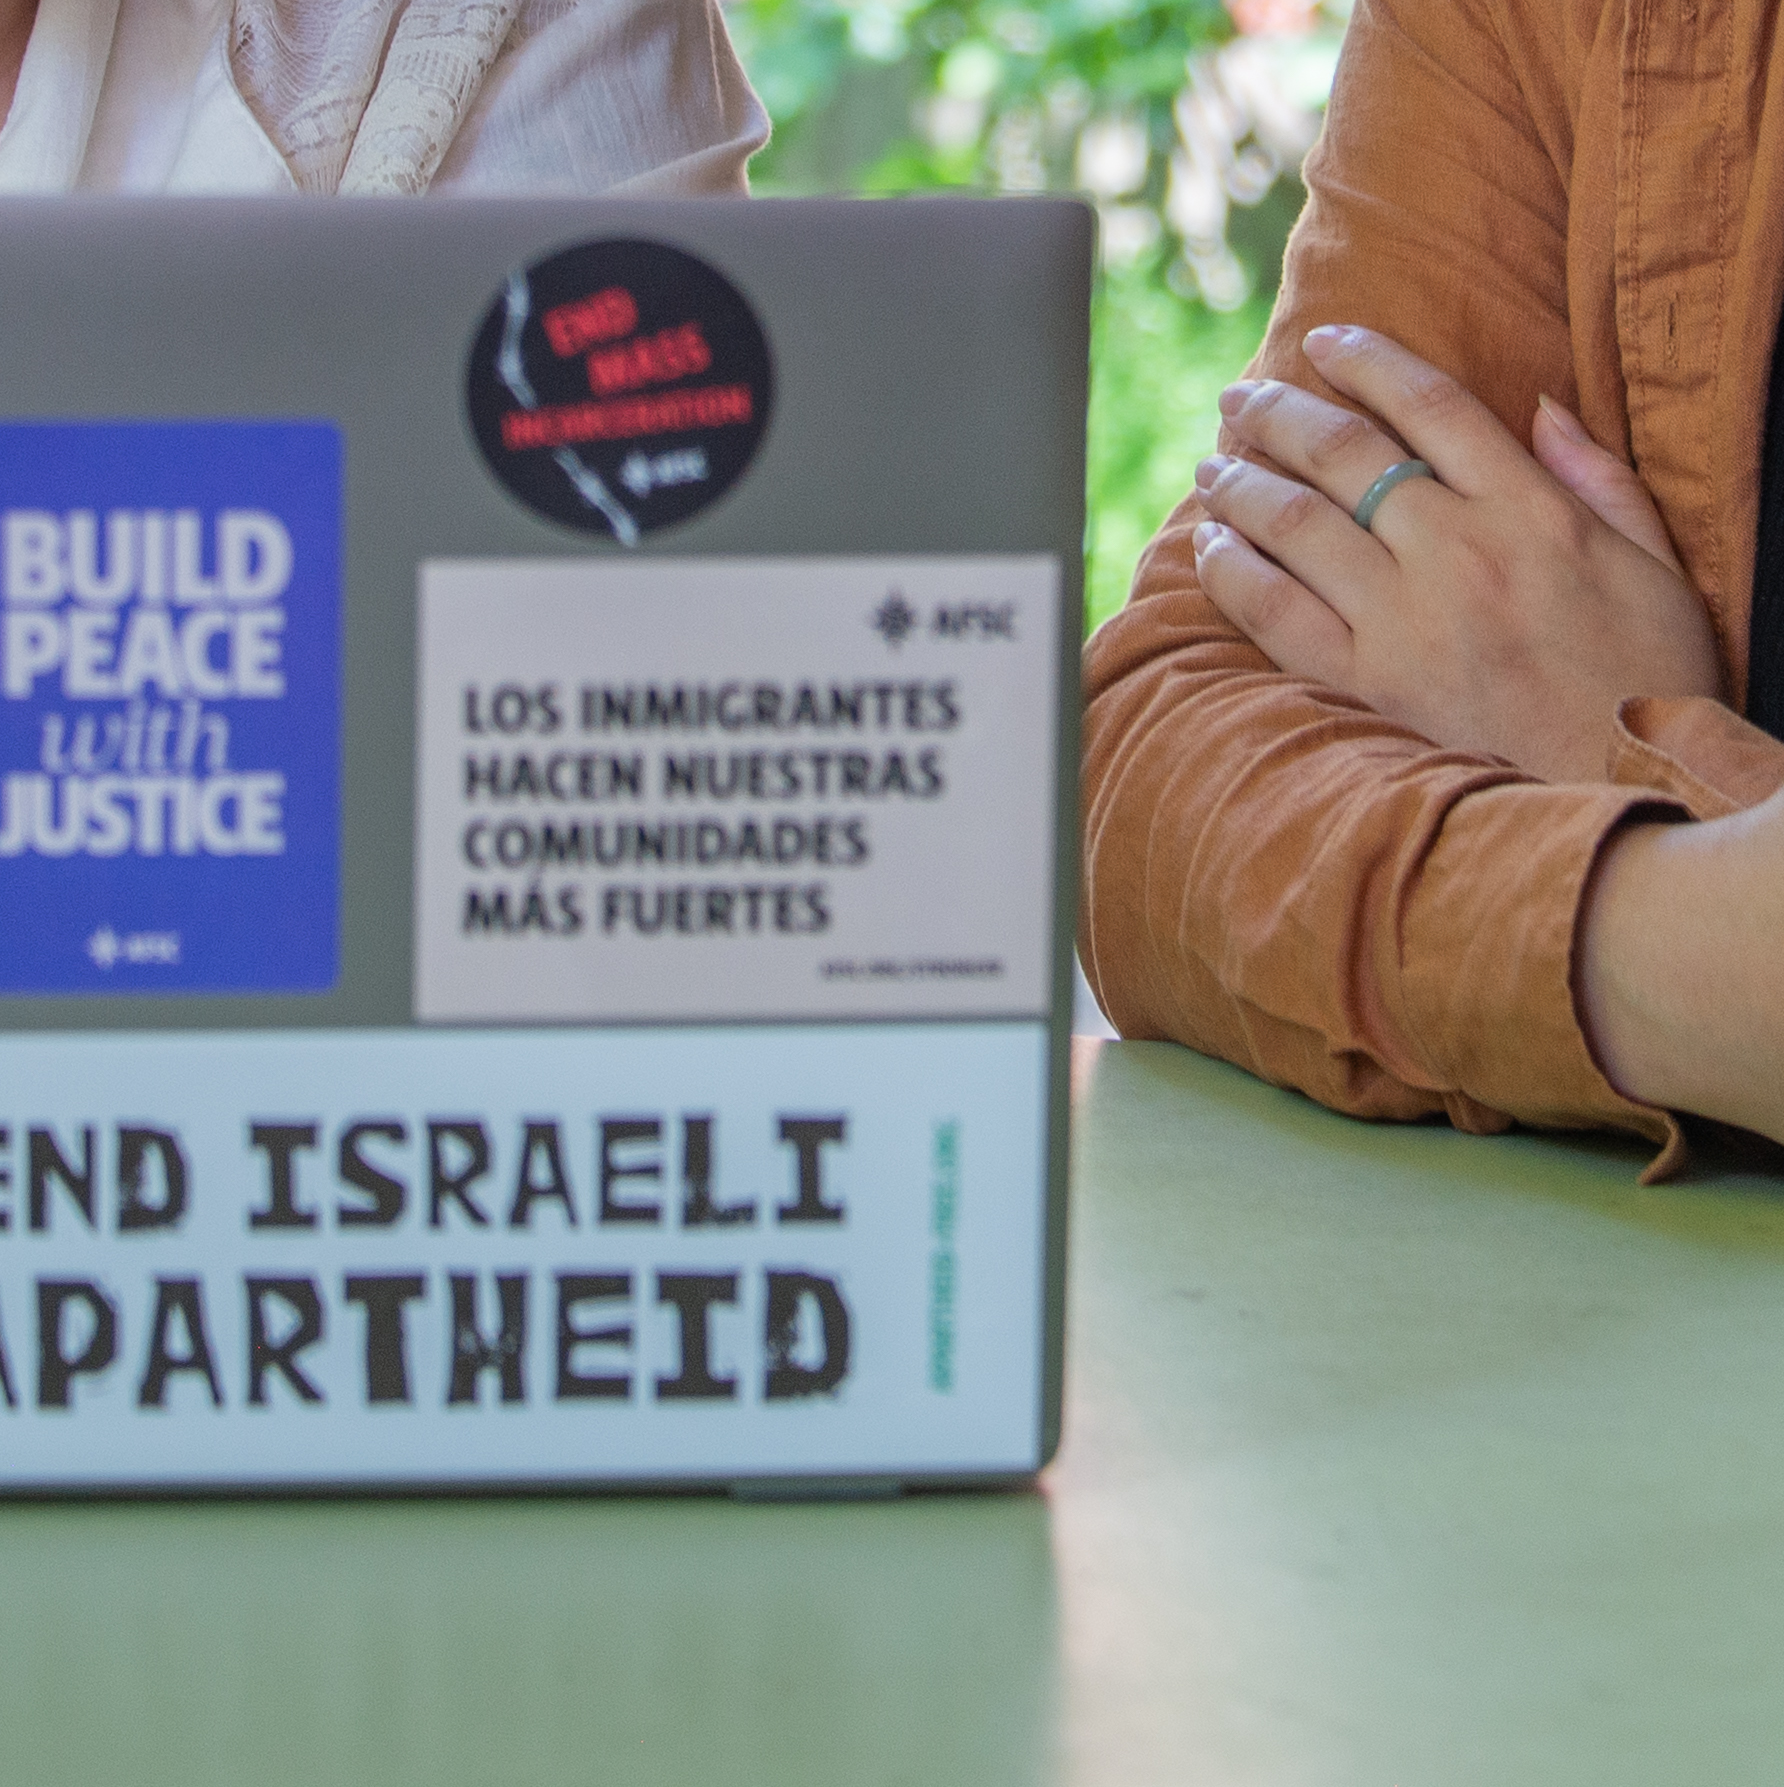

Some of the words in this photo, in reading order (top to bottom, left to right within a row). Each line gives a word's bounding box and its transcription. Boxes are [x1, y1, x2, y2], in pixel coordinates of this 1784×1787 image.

[2, 511, 292, 605] BUILD
[2, 609, 284, 700] PEACE
[931, 602, 1016, 640] AFSC
[41, 699, 232, 772] with
[464, 684, 563, 736] LOS
[580, 682, 960, 733] INMIGRANTES
[465, 752, 644, 802] HACEN
[663, 749, 944, 800] NUESTRAS
[463, 817, 869, 870] COMUNIDADES
[463, 868, 583, 936] MÁS
[602, 884, 831, 935] FUERTES
[248, 1115, 847, 1232] ISRAELI
